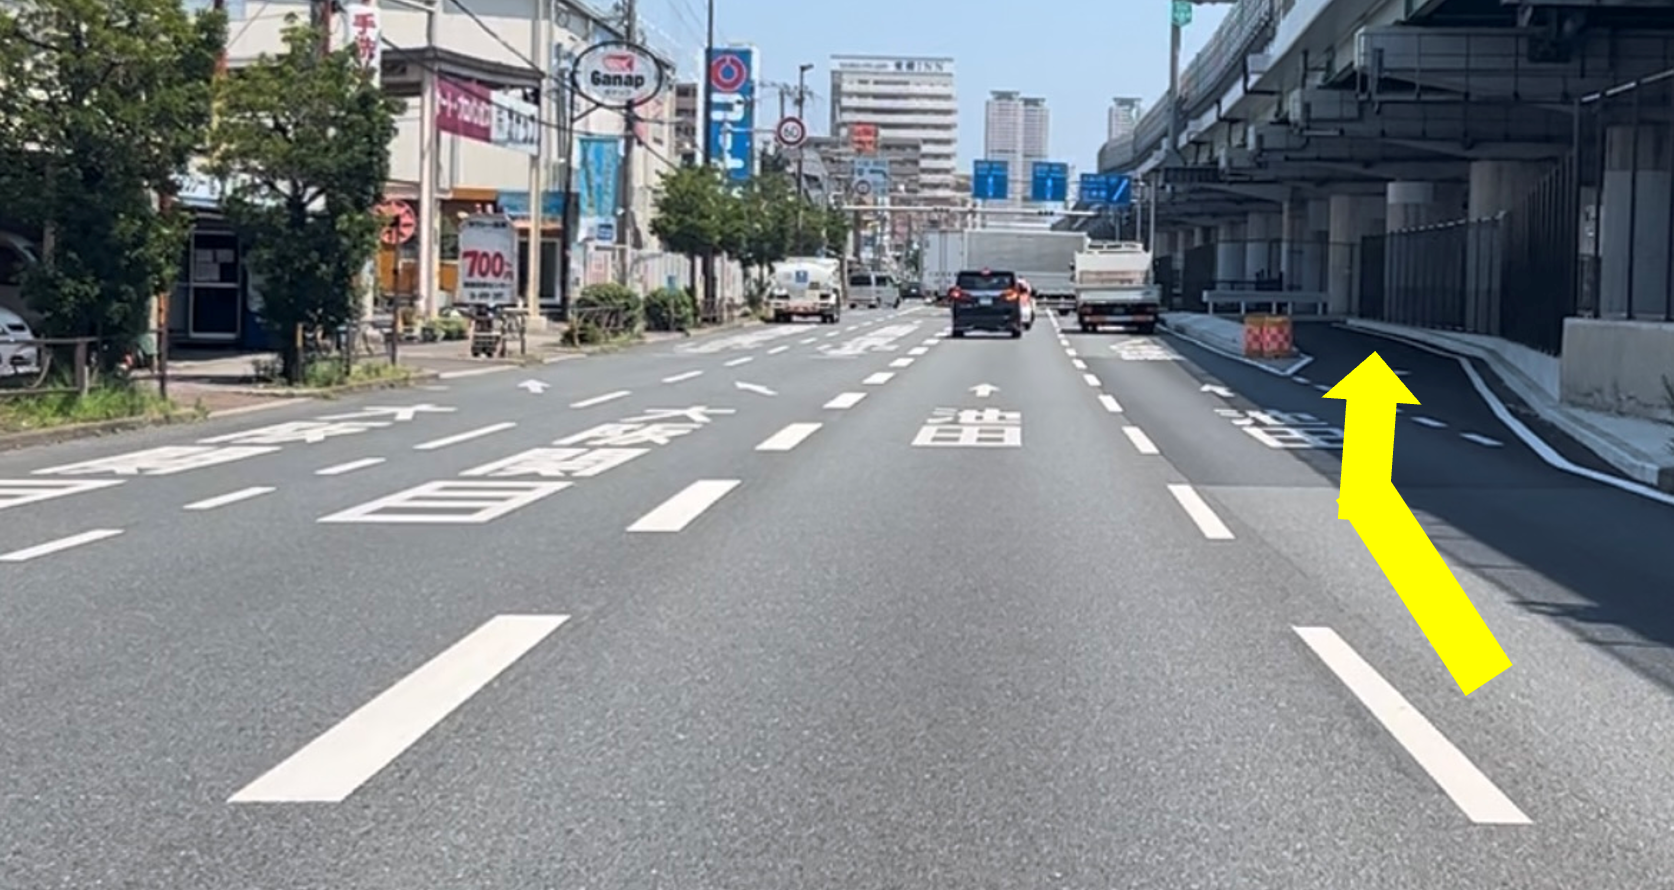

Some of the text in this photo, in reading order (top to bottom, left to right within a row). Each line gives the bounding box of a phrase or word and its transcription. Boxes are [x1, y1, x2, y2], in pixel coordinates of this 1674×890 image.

[591, 70, 645, 89] Ganap
[784, 125, 800, 139] 60
[911, 407, 1022, 447] 池田
